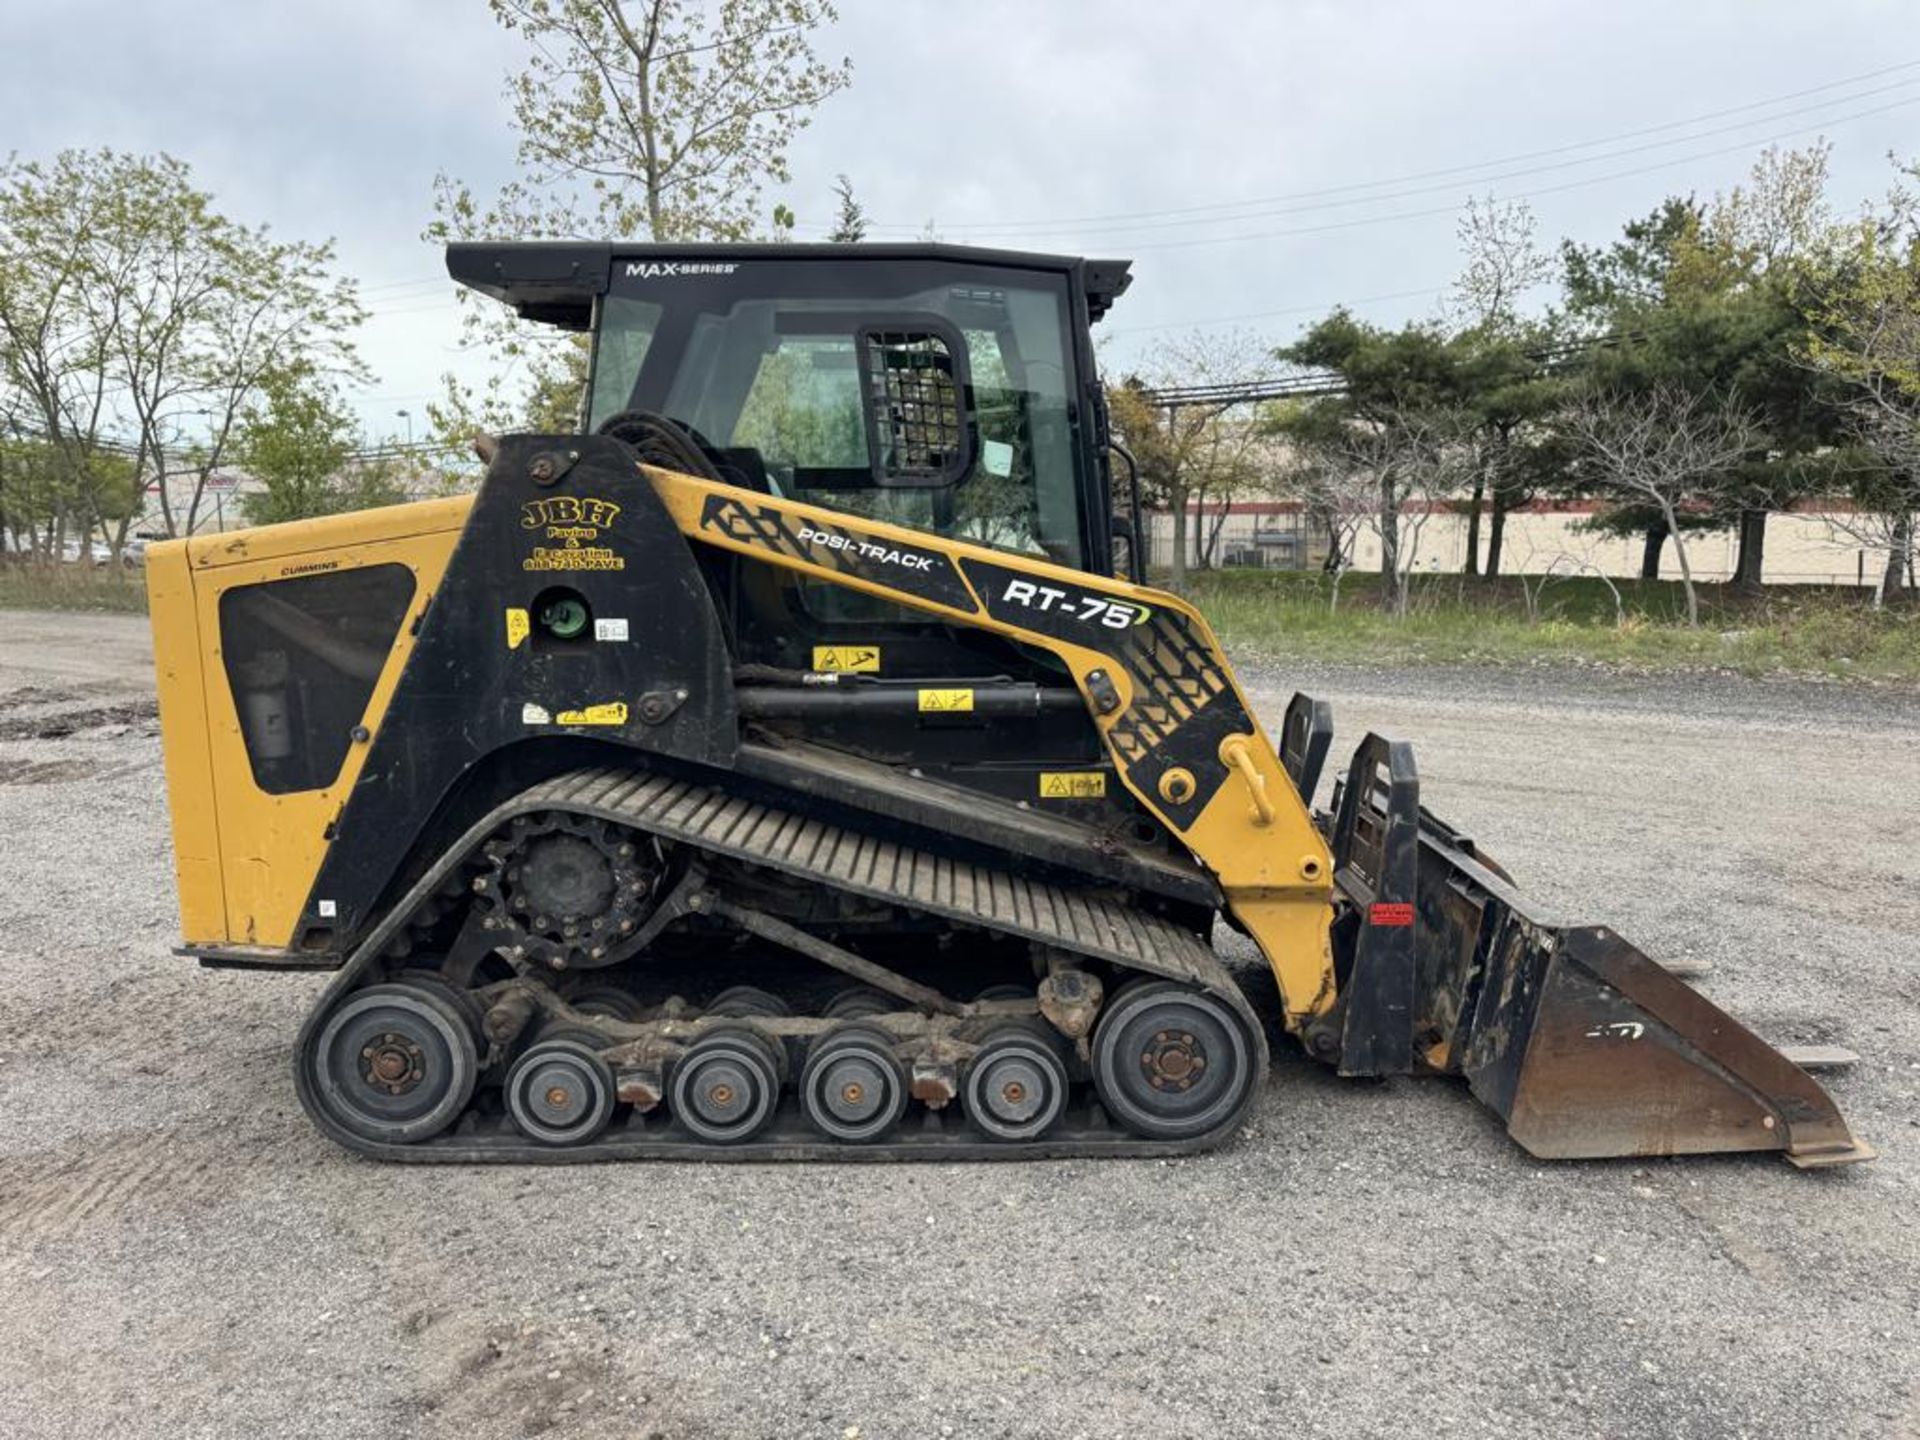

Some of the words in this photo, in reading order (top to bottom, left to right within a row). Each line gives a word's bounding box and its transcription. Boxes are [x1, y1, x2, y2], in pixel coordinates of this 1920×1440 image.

[520, 496, 621, 529] JBH
[547, 527, 597, 539] Paving
[798, 528, 934, 572] POSI-TRACK
[281, 561, 338, 576] CUMMINS
[1002, 579, 1135, 629] RT-75
